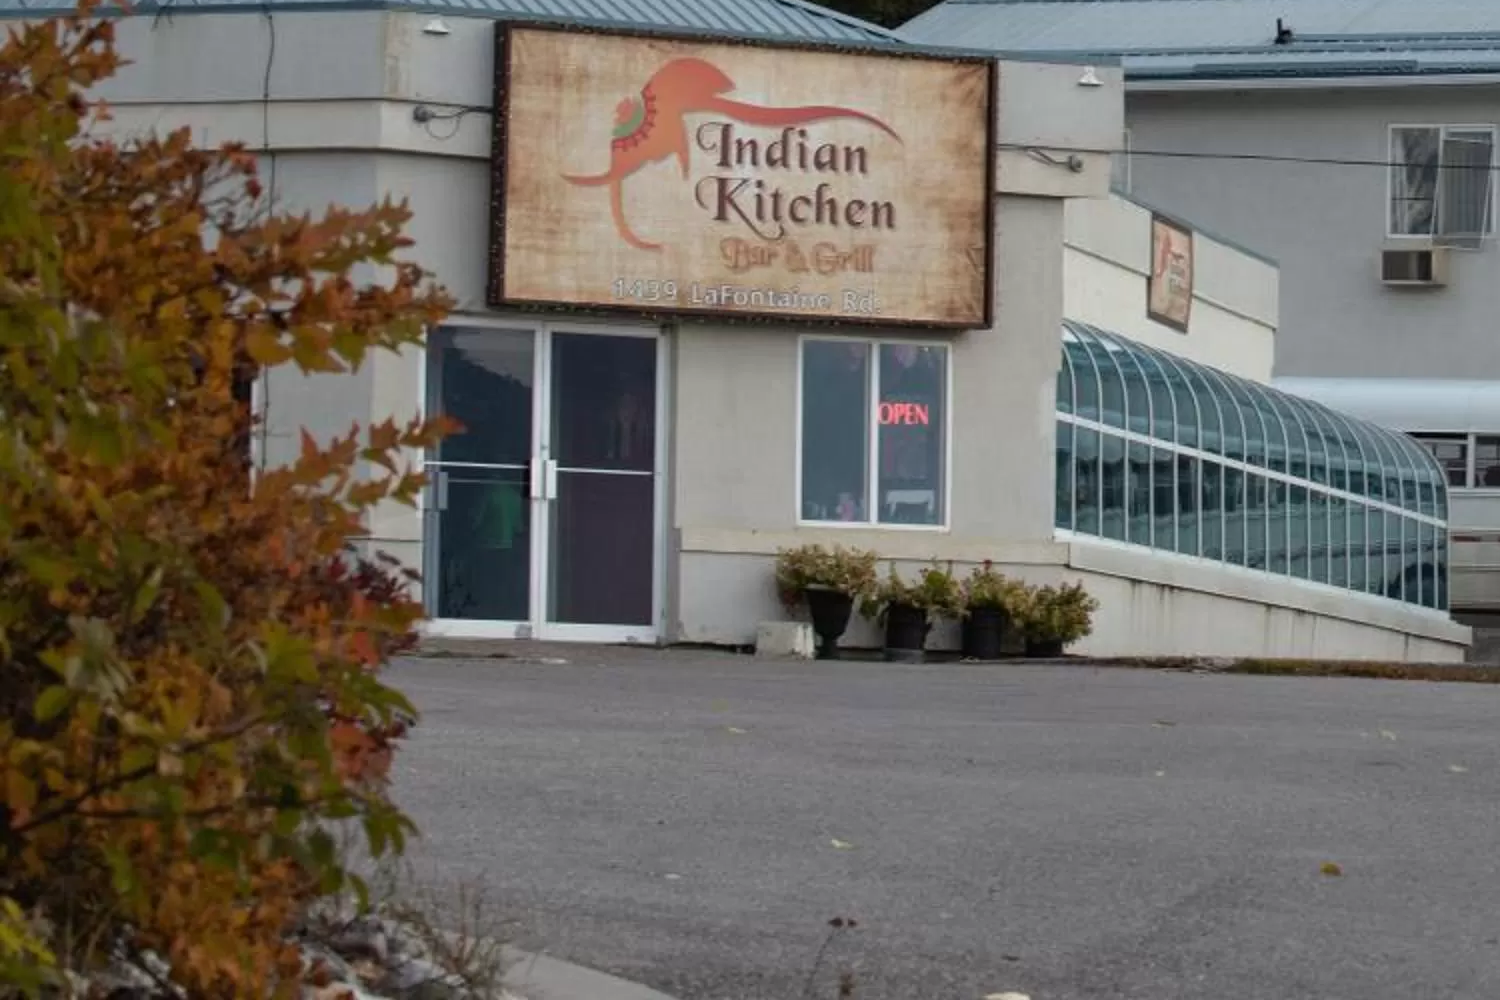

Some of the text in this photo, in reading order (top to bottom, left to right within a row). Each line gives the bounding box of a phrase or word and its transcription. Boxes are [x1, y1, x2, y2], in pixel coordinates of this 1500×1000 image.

[696, 121, 868, 174] Indian
[695, 176, 897, 241] Kitchen
[719, 237, 779, 274] Bar
[814, 241, 878, 275] Grill
[613, 278, 678, 301] 1439
[691, 284, 832, 310] LaFontaine
[877, 403, 929, 425] OPEN
